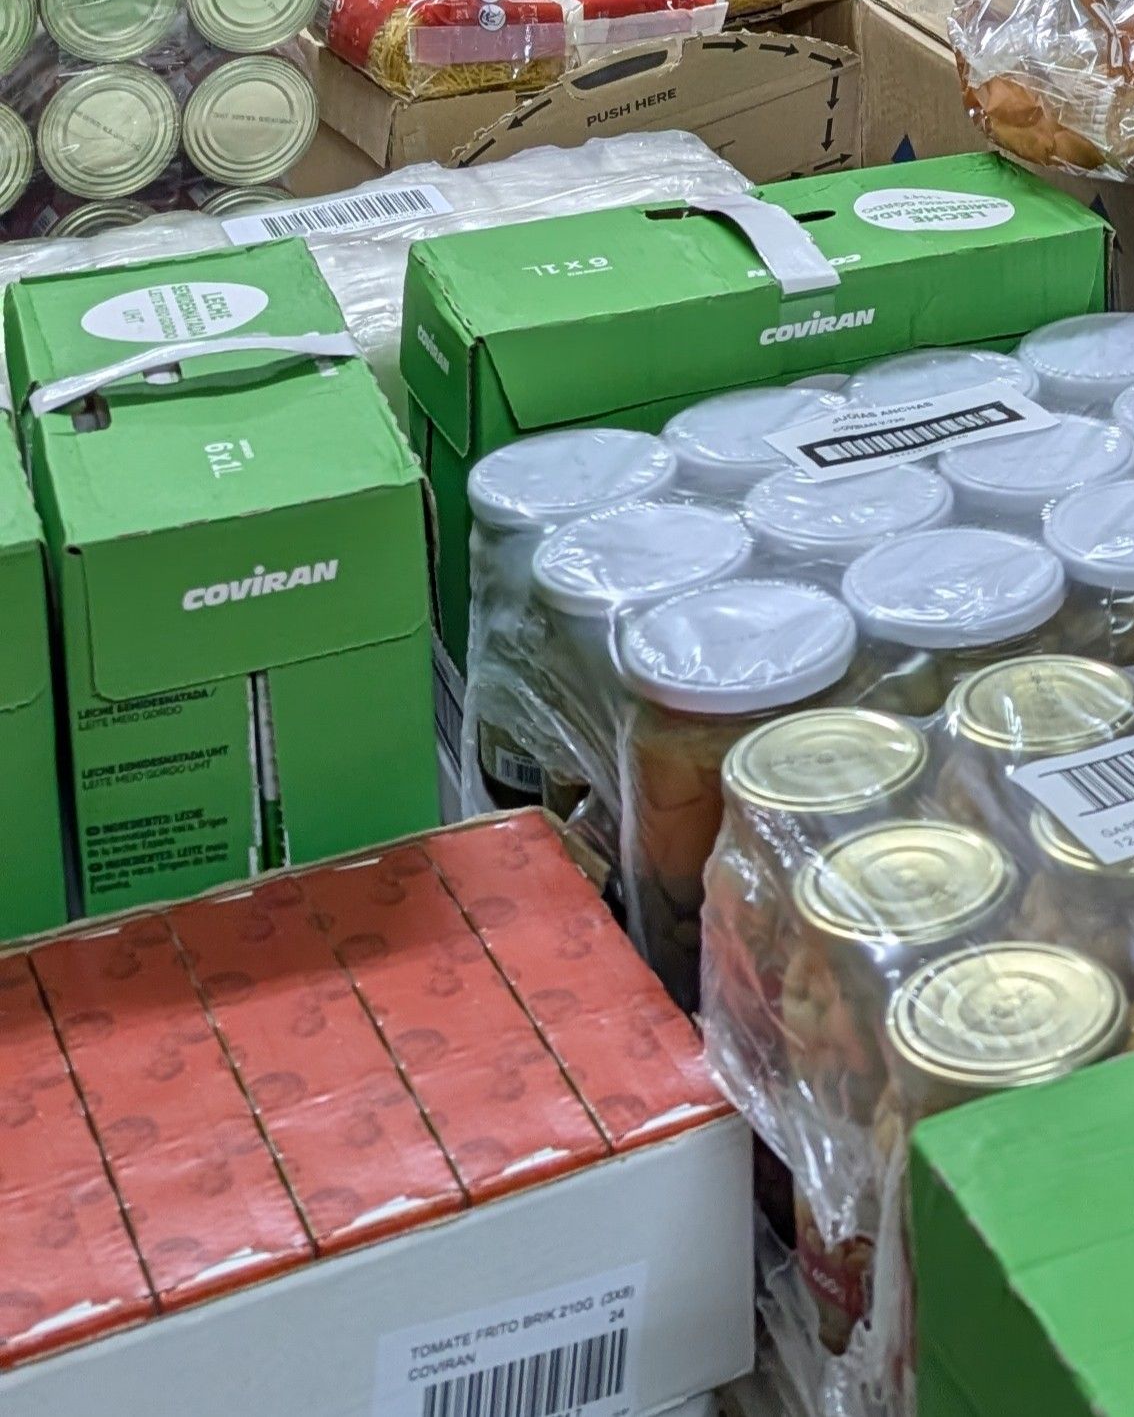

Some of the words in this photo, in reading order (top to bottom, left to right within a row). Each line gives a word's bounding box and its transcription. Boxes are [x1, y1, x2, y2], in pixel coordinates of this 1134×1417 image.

[587, 100, 631, 128] PUSH
[634, 87, 677, 114] HERE
[865, 201, 1009, 222] SEMIDESNATADA
[913, 210, 987, 225] LECHE
[522, 264, 560, 277] 1L
[588, 256, 609, 268] 6
[122, 308, 145, 325] UHT
[171, 284, 208, 338] SEMIDESNATADA
[201, 291, 233, 321] LECHE
[759, 307, 876, 346] COVIRAN
[417, 324, 450, 376] COVIRAN
[181, 558, 339, 611] COVIRAN
[77, 719, 109, 732] LEITE
[112, 713, 139, 726] MEIO
[81, 764, 116, 780] LECHE
[118, 750, 205, 773] SEMIDESNATADA
[204, 744, 230, 759] UHT
[188, 759, 213, 772] UHT
[410, 1332, 472, 1360] TOMATE
[474, 1318, 520, 1344] FRITO
[522, 1308, 558, 1330] BRIK
[557, 1296, 595, 1319] 210G
[607, 1307, 626, 1324] 24
[407, 1351, 478, 1382] COVIRAN
